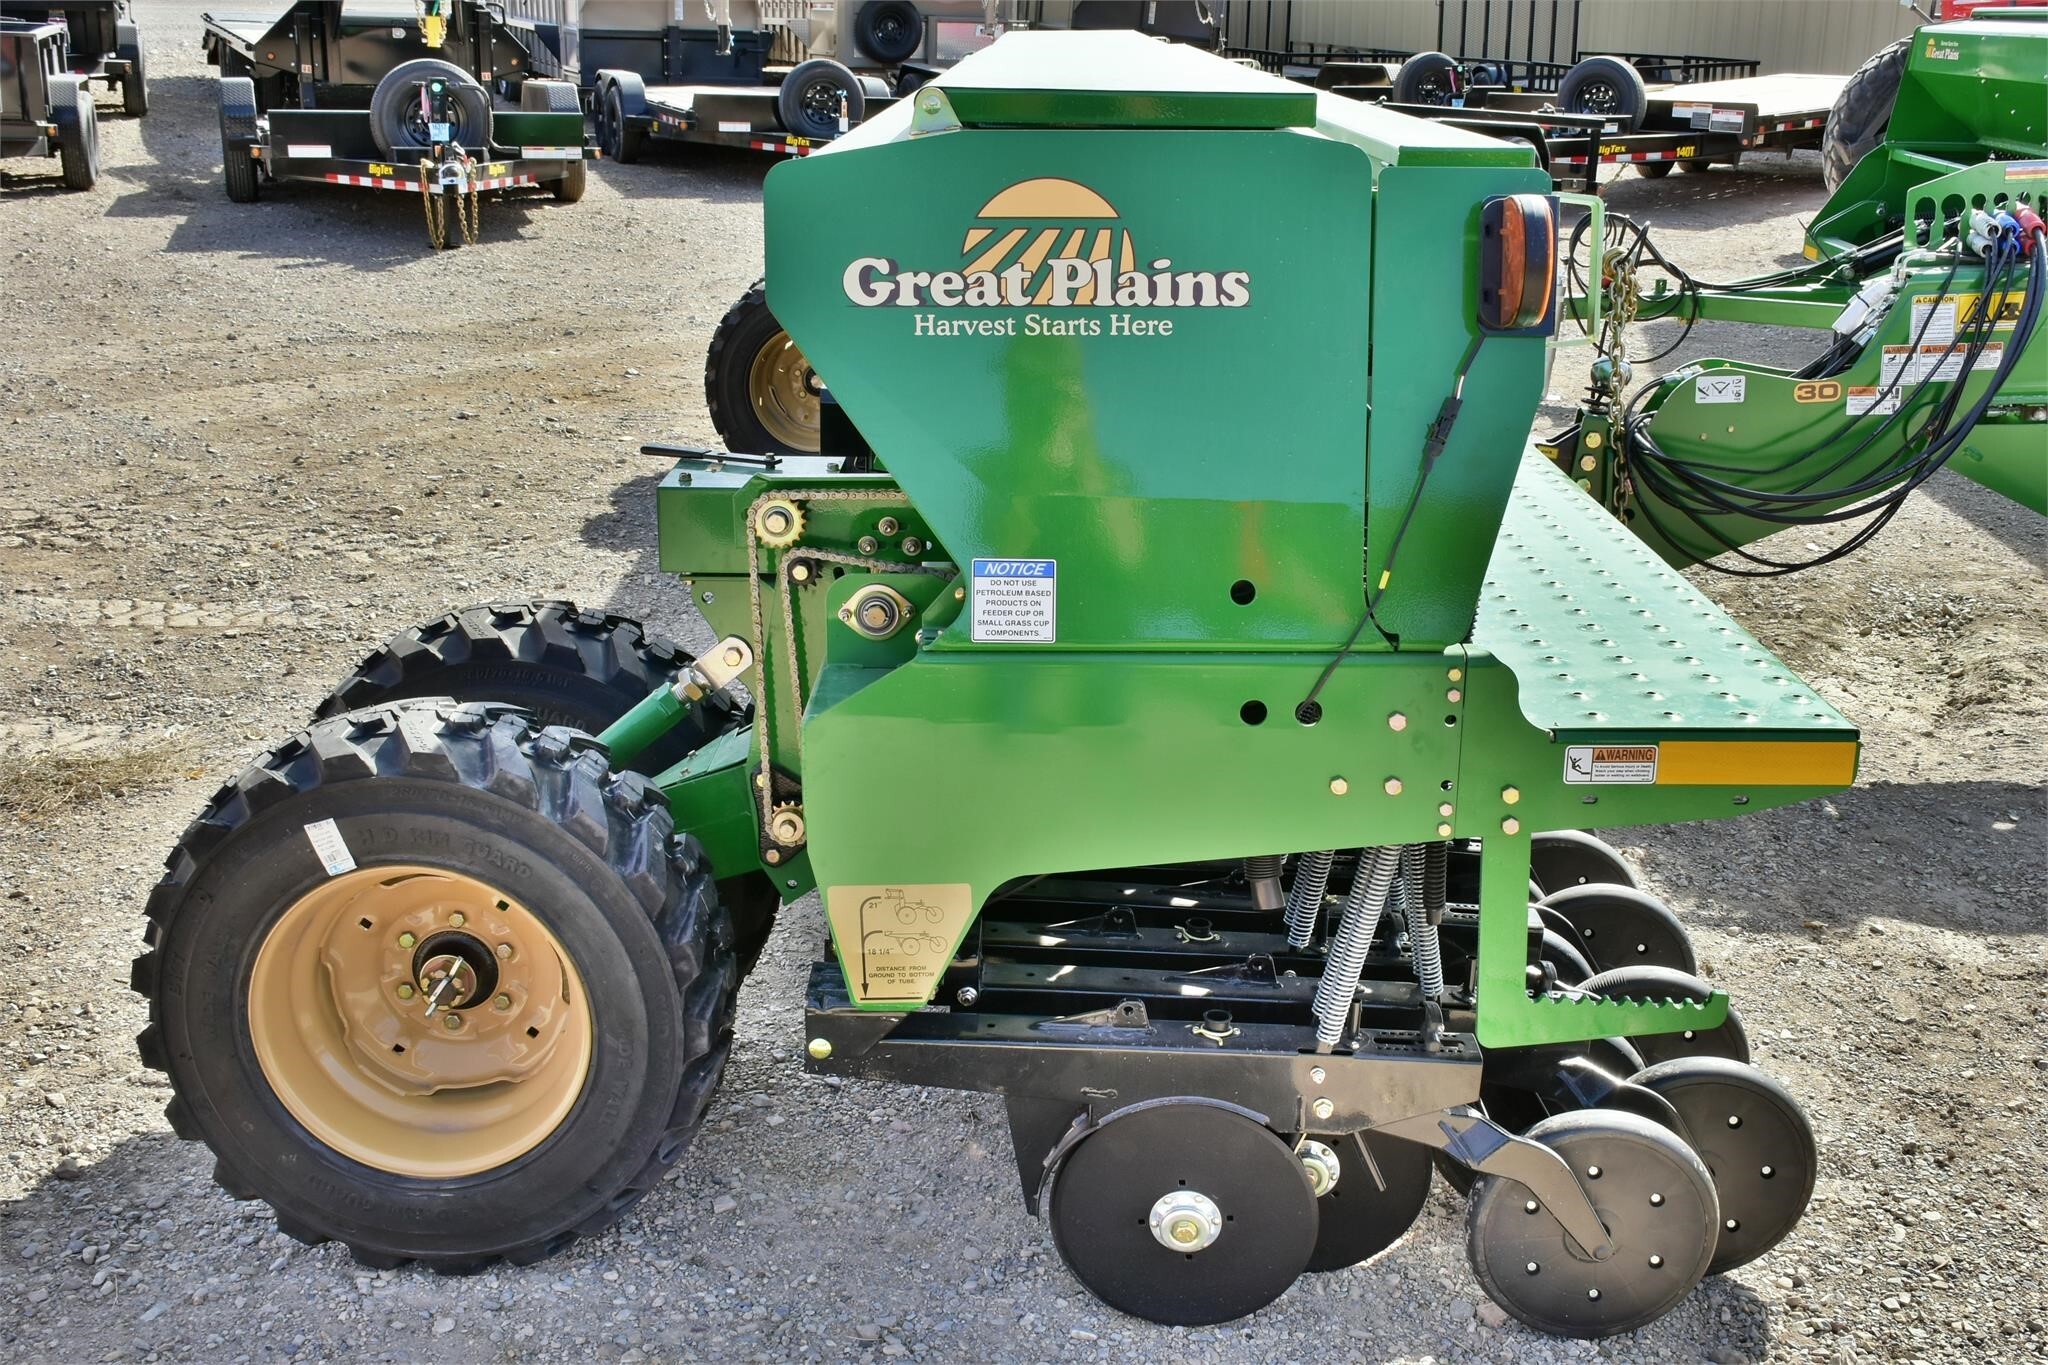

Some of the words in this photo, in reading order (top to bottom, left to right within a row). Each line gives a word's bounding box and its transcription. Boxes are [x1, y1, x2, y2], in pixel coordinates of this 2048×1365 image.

[1676, 146, 1696, 158] 140T
[842, 257, 1033, 306] Great
[1047, 257, 1251, 306] Plains
[913, 313, 1016, 337] Harvest
[1024, 313, 1101, 337] Starts
[1110, 313, 1173, 337] Here
[1797, 383, 1839, 400] 30
[984, 563, 1047, 576] NOTICE
[1606, 749, 1653, 761] WARNING
